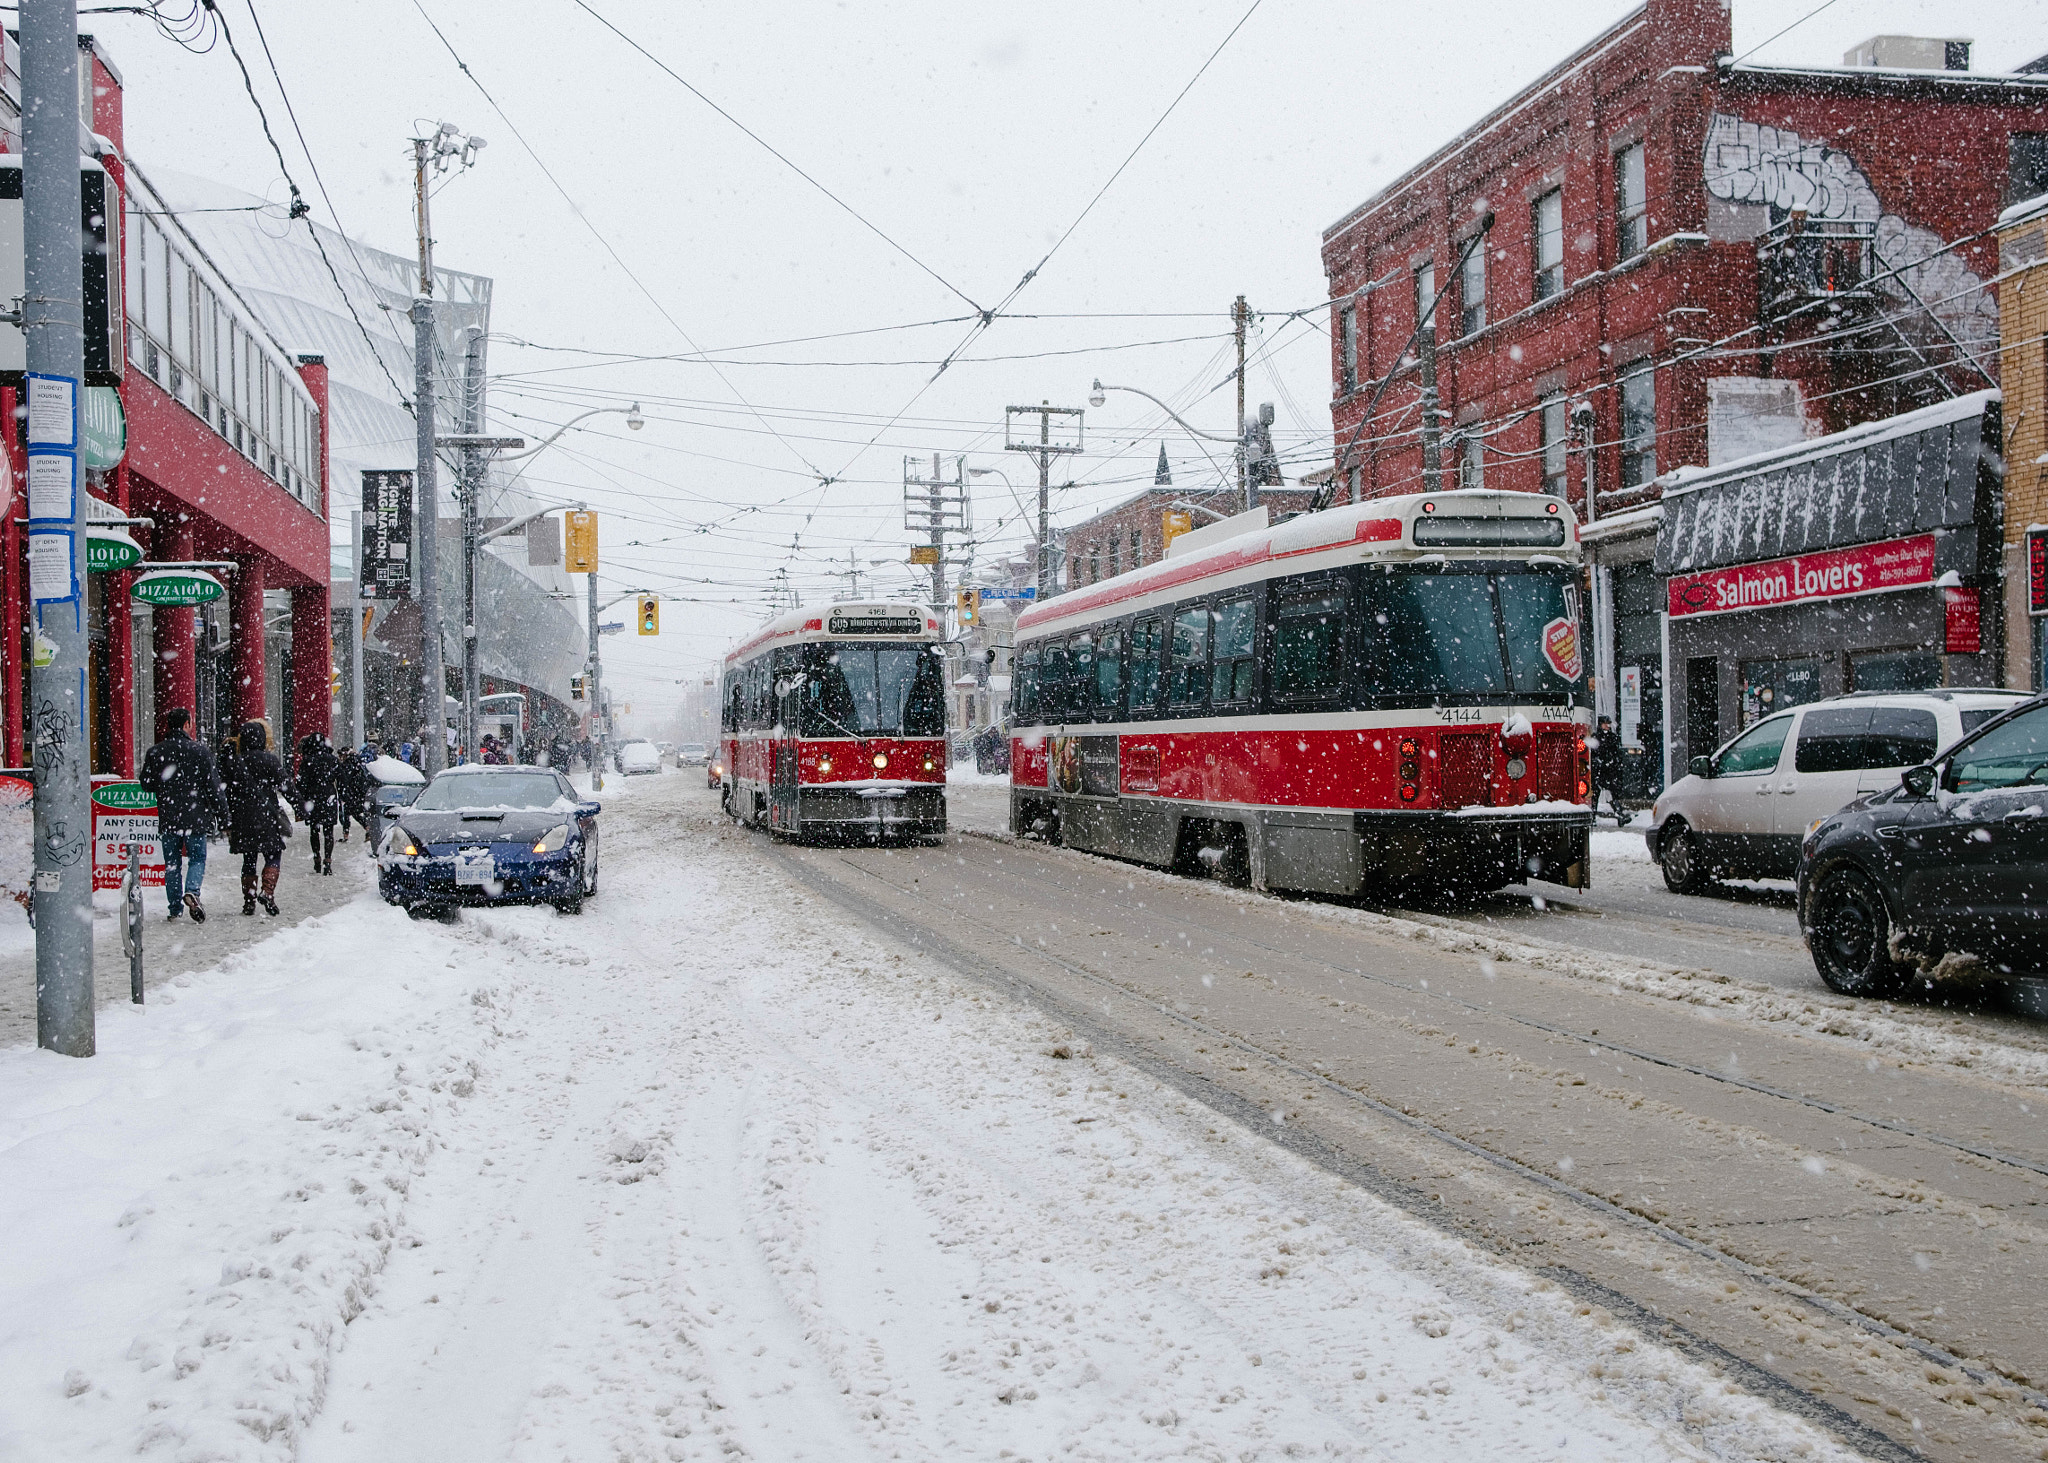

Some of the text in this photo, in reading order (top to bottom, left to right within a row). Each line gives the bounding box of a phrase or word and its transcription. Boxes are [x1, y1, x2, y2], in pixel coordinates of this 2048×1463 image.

[37, 384, 63, 392] STUDENT
[388, 484, 400, 530] IGNITE
[376, 474, 389, 560] IMAGINATION
[2030, 537, 2046, 605] HAGEN
[138, 584, 214, 597] PIZZAIOLO
[1716, 560, 1863, 607] Salmon Lovers
[1550, 626, 1568, 643] STOP
[1441, 708, 1482, 723] 4144
[1542, 706, 1569, 721] 4144
[100, 792, 157, 801] PIZZAIOL
[104, 819, 159, 827] ANY SLICE
[98, 833, 162, 841] ANY DRINK
